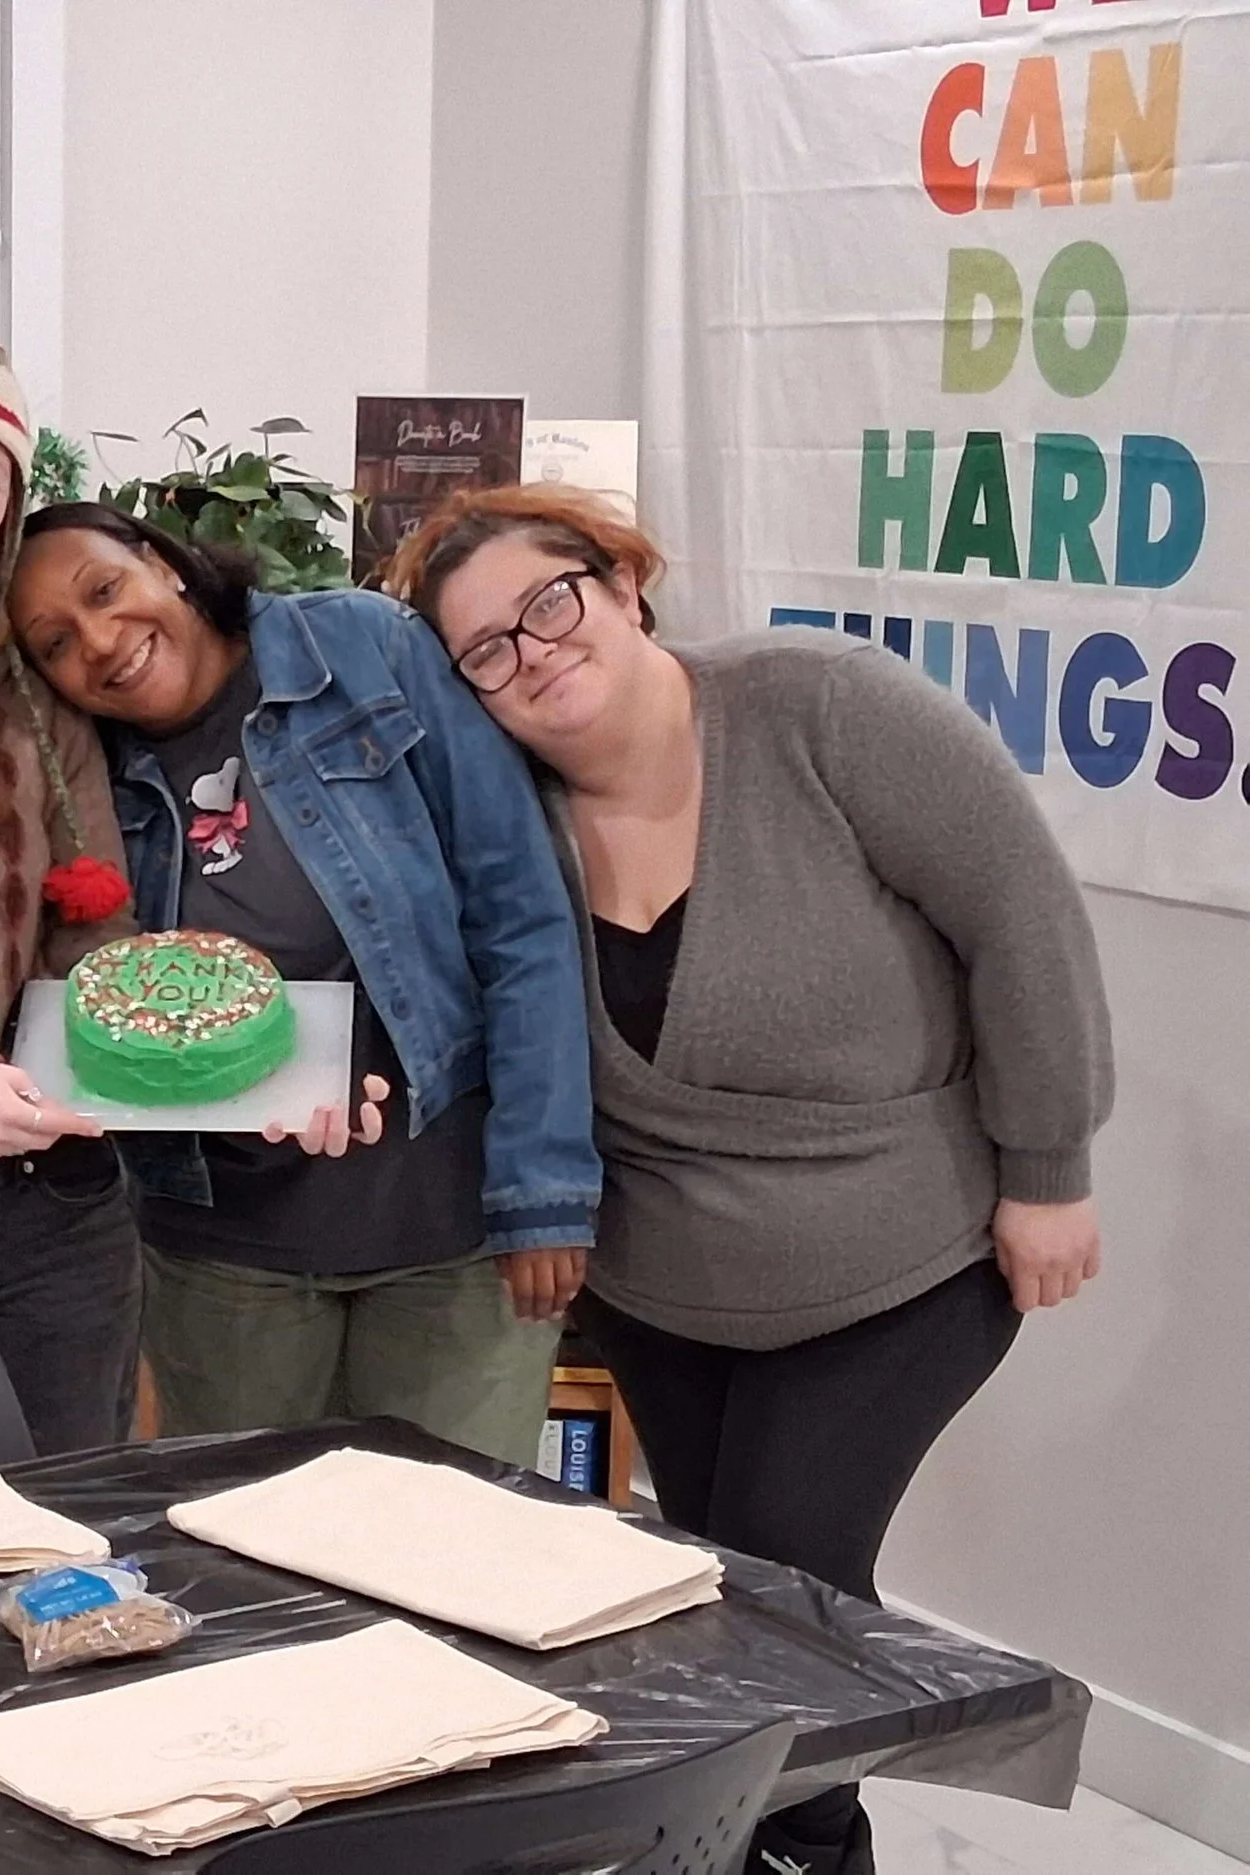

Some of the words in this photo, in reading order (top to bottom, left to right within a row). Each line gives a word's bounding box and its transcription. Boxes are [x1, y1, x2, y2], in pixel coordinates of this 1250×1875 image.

[920, 43, 1182, 215] CAN
[941, 240, 1130, 398] DO
[857, 430, 1206, 589] HARD
